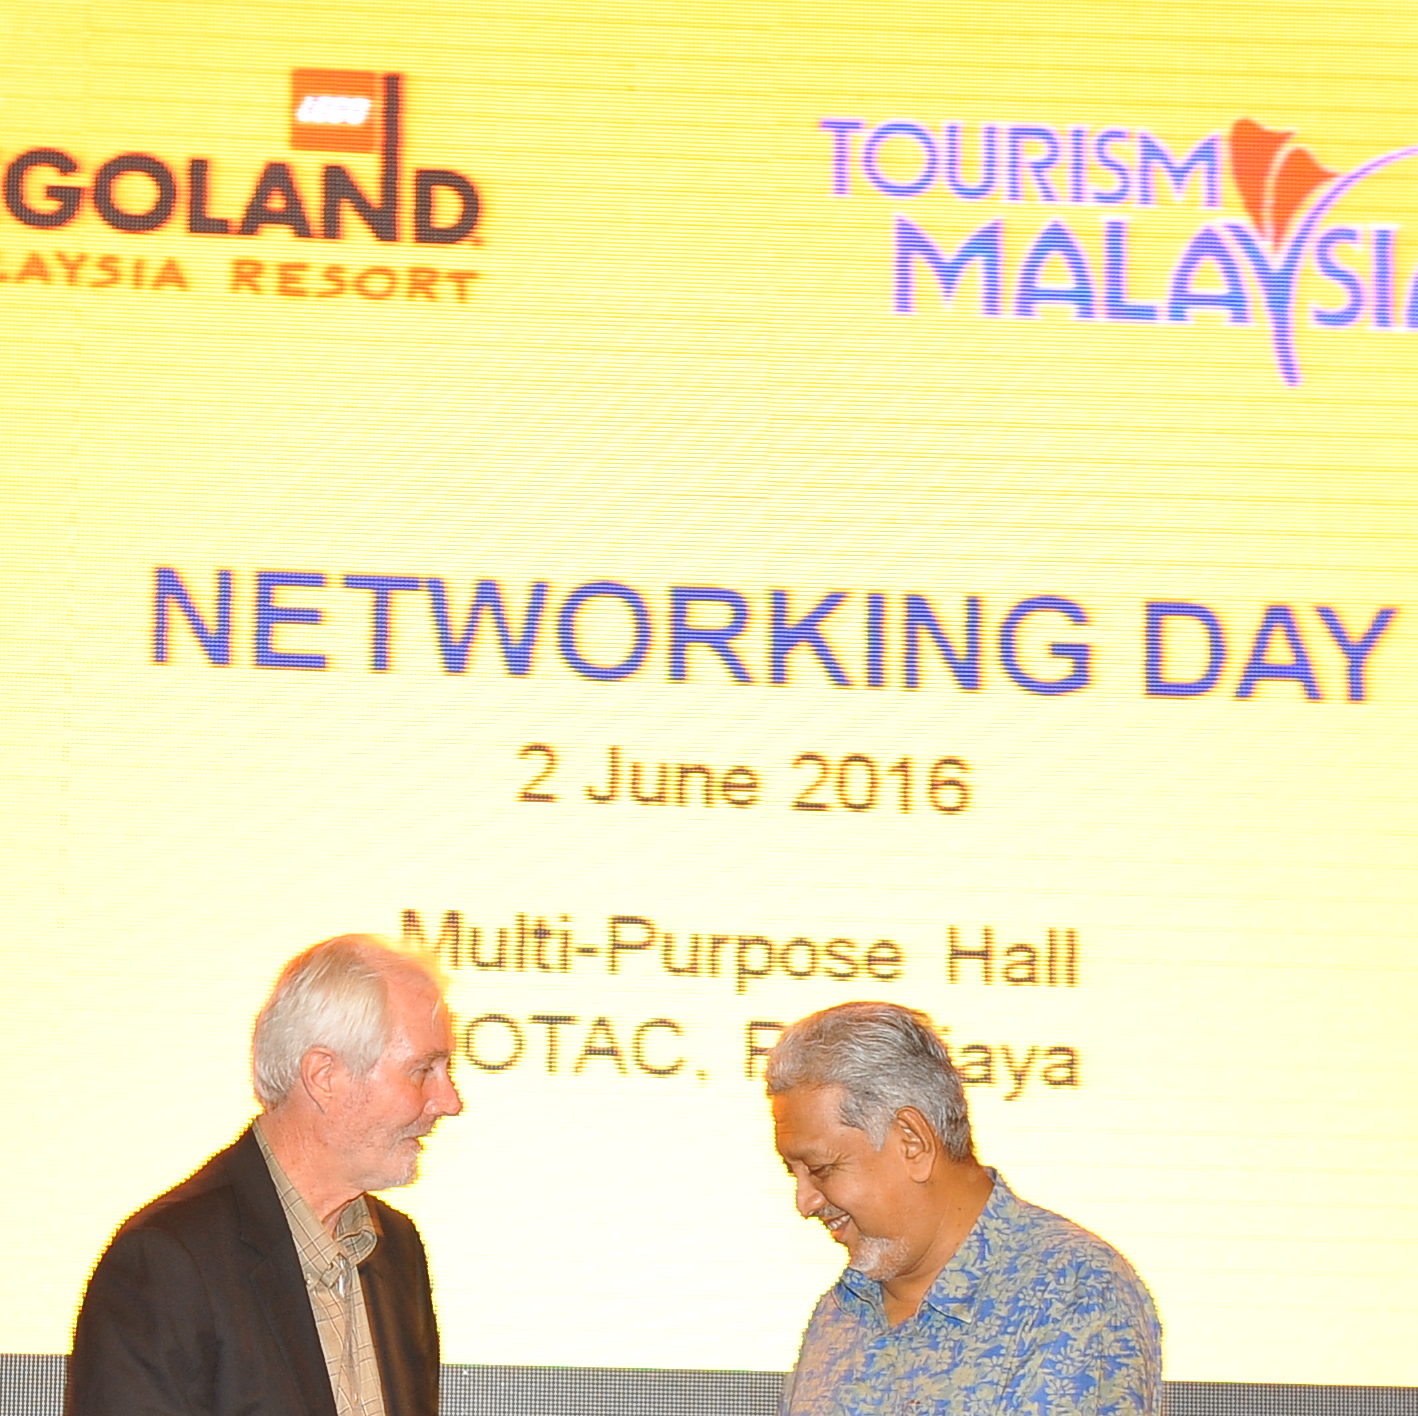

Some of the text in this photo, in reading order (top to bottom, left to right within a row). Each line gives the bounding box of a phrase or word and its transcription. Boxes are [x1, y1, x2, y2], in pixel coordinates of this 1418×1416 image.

[819, 118, 1224, 209] TOURISM
[229, 259, 480, 303] RESORT
[149, 566, 1401, 703] NETWORKING DAY
[515, 742, 975, 815] 2 June 2016
[399, 908, 1081, 996] Multi-Purpose Hall
[451, 1013, 709, 1089] OTAC,
